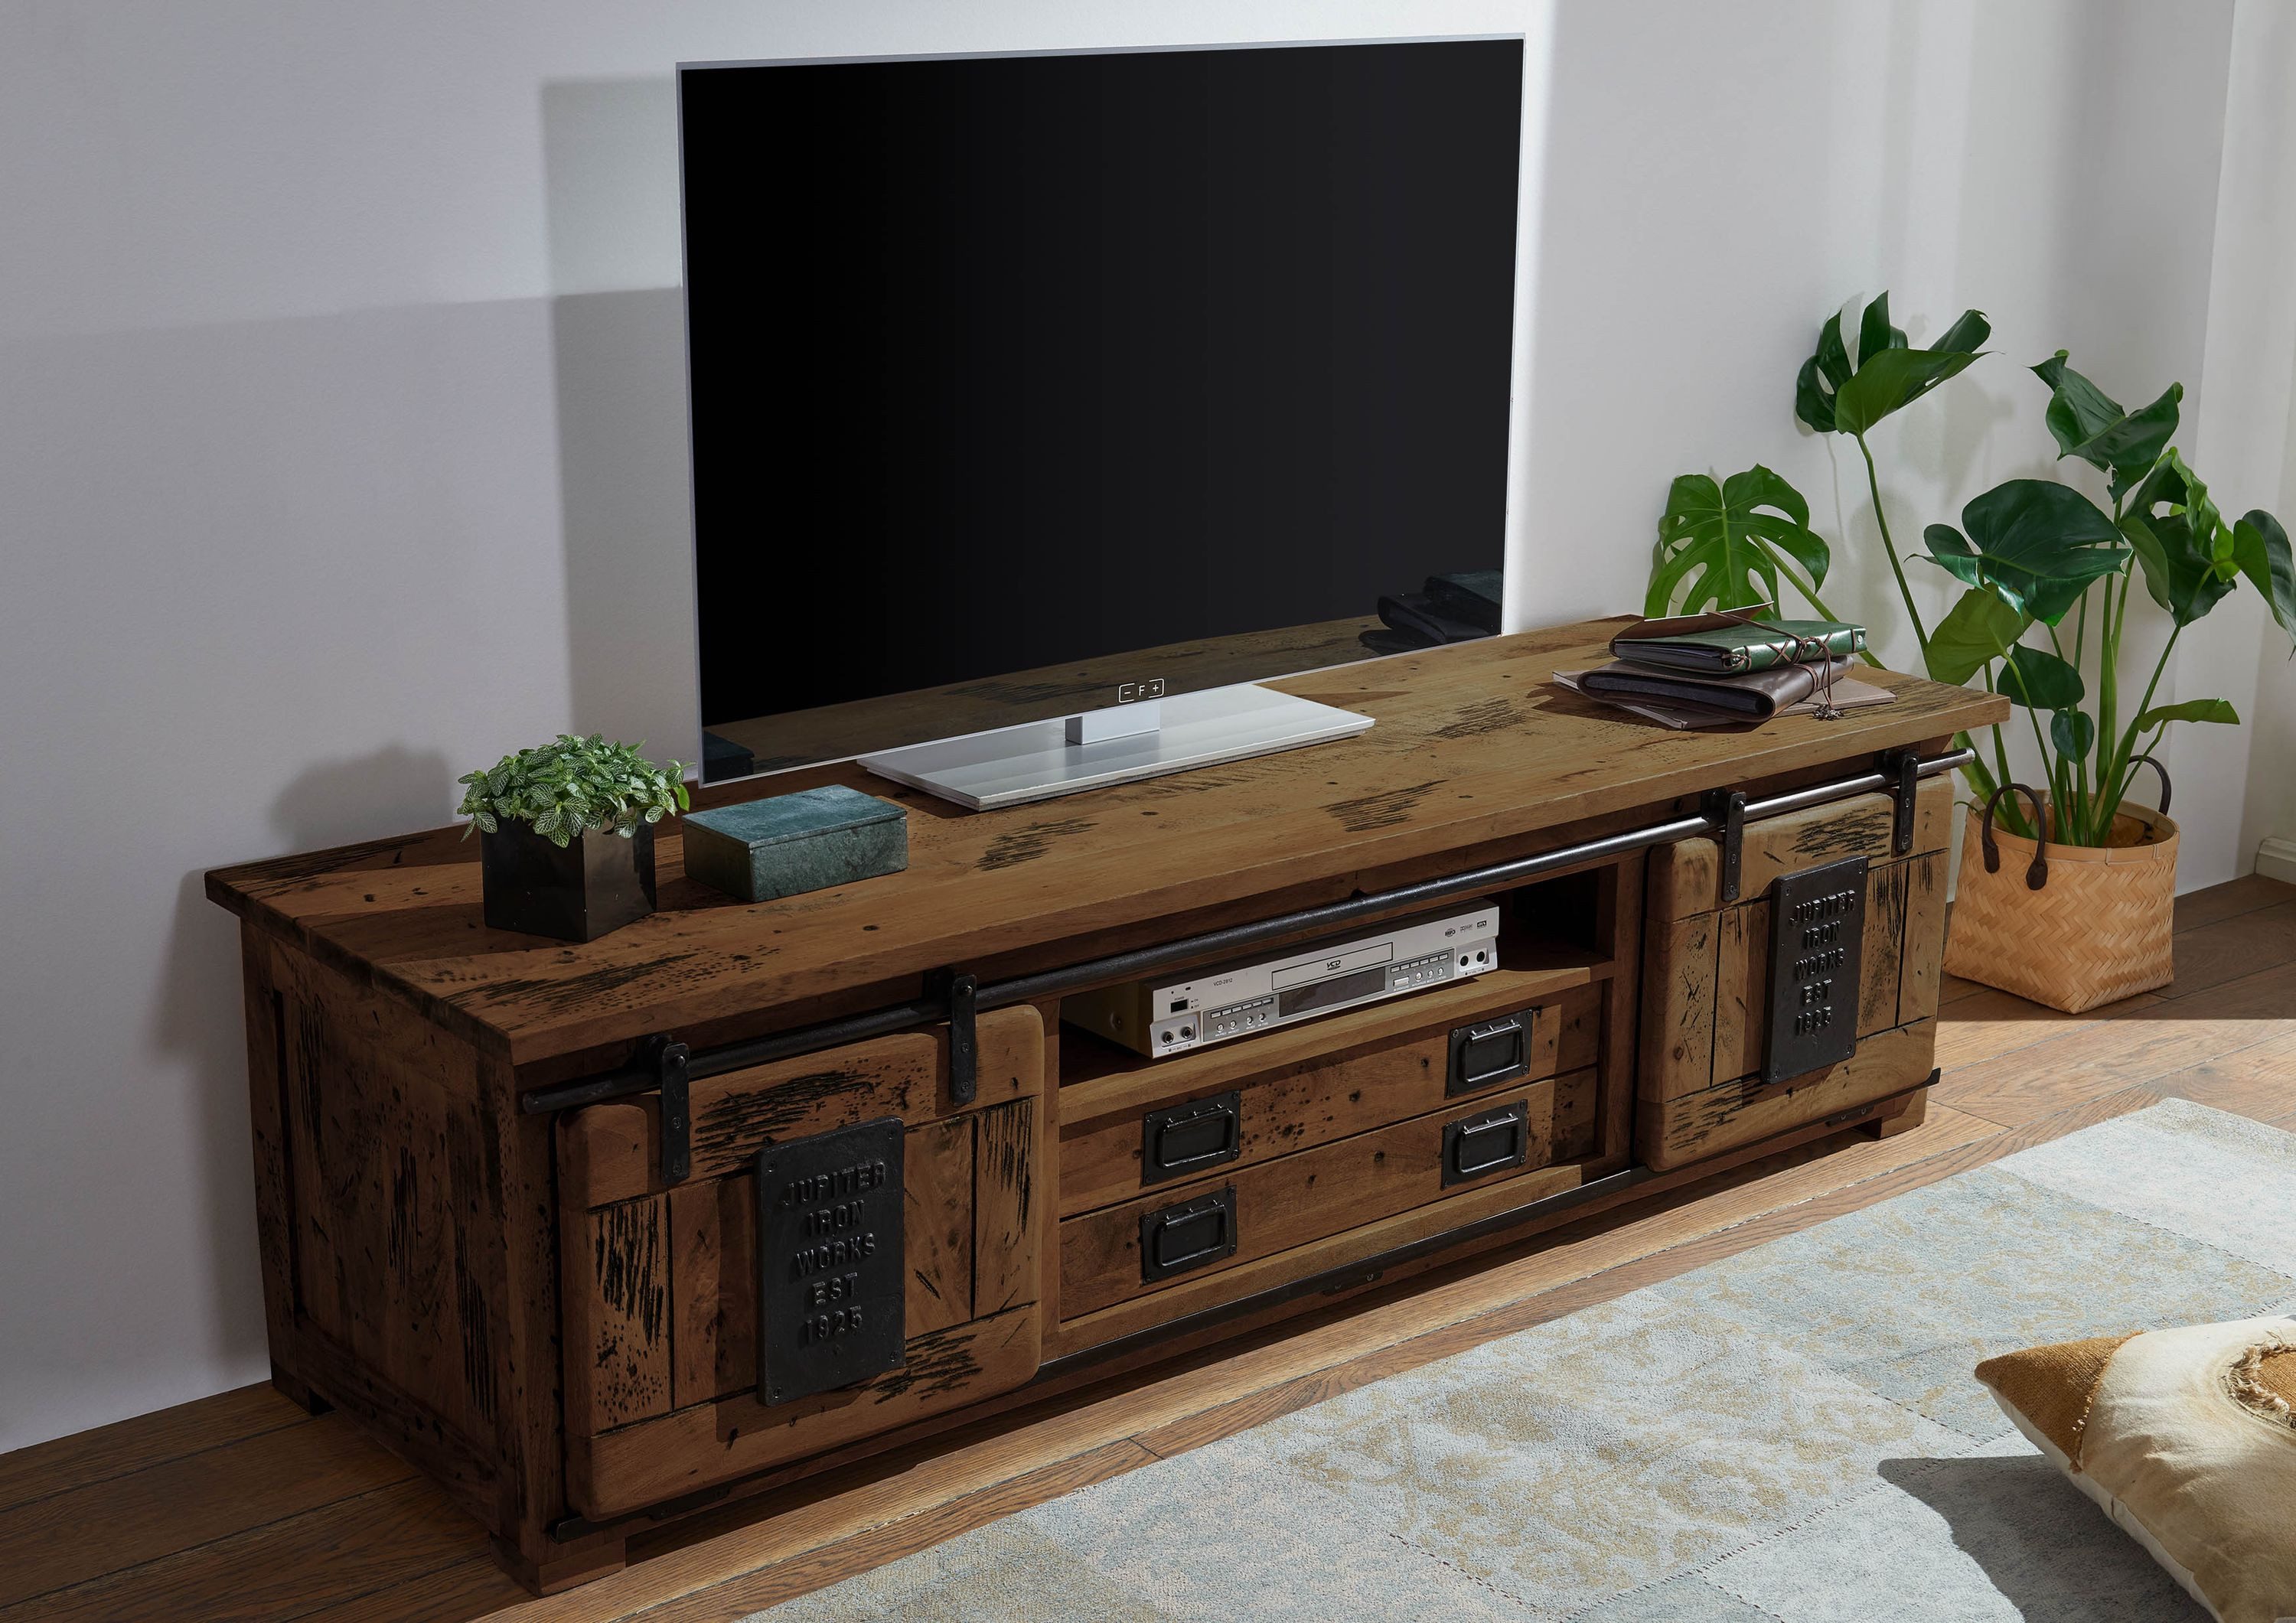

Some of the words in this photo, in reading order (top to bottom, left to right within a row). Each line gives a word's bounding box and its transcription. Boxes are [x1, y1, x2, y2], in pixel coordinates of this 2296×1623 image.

[1139, 685, 1145, 696] F
[1789, 889, 1855, 926] JUPITER
[1805, 921, 1841, 950] IRON
[1326, 960, 1341, 968] VCD
[1794, 947, 1844, 979] WORKS
[1802, 979, 1832, 1005] EST
[780, 1161, 885, 1206] JUPITER
[807, 1199, 865, 1237] IRON
[796, 1232, 876, 1276] WORKS
[811, 1272, 858, 1306] EST
